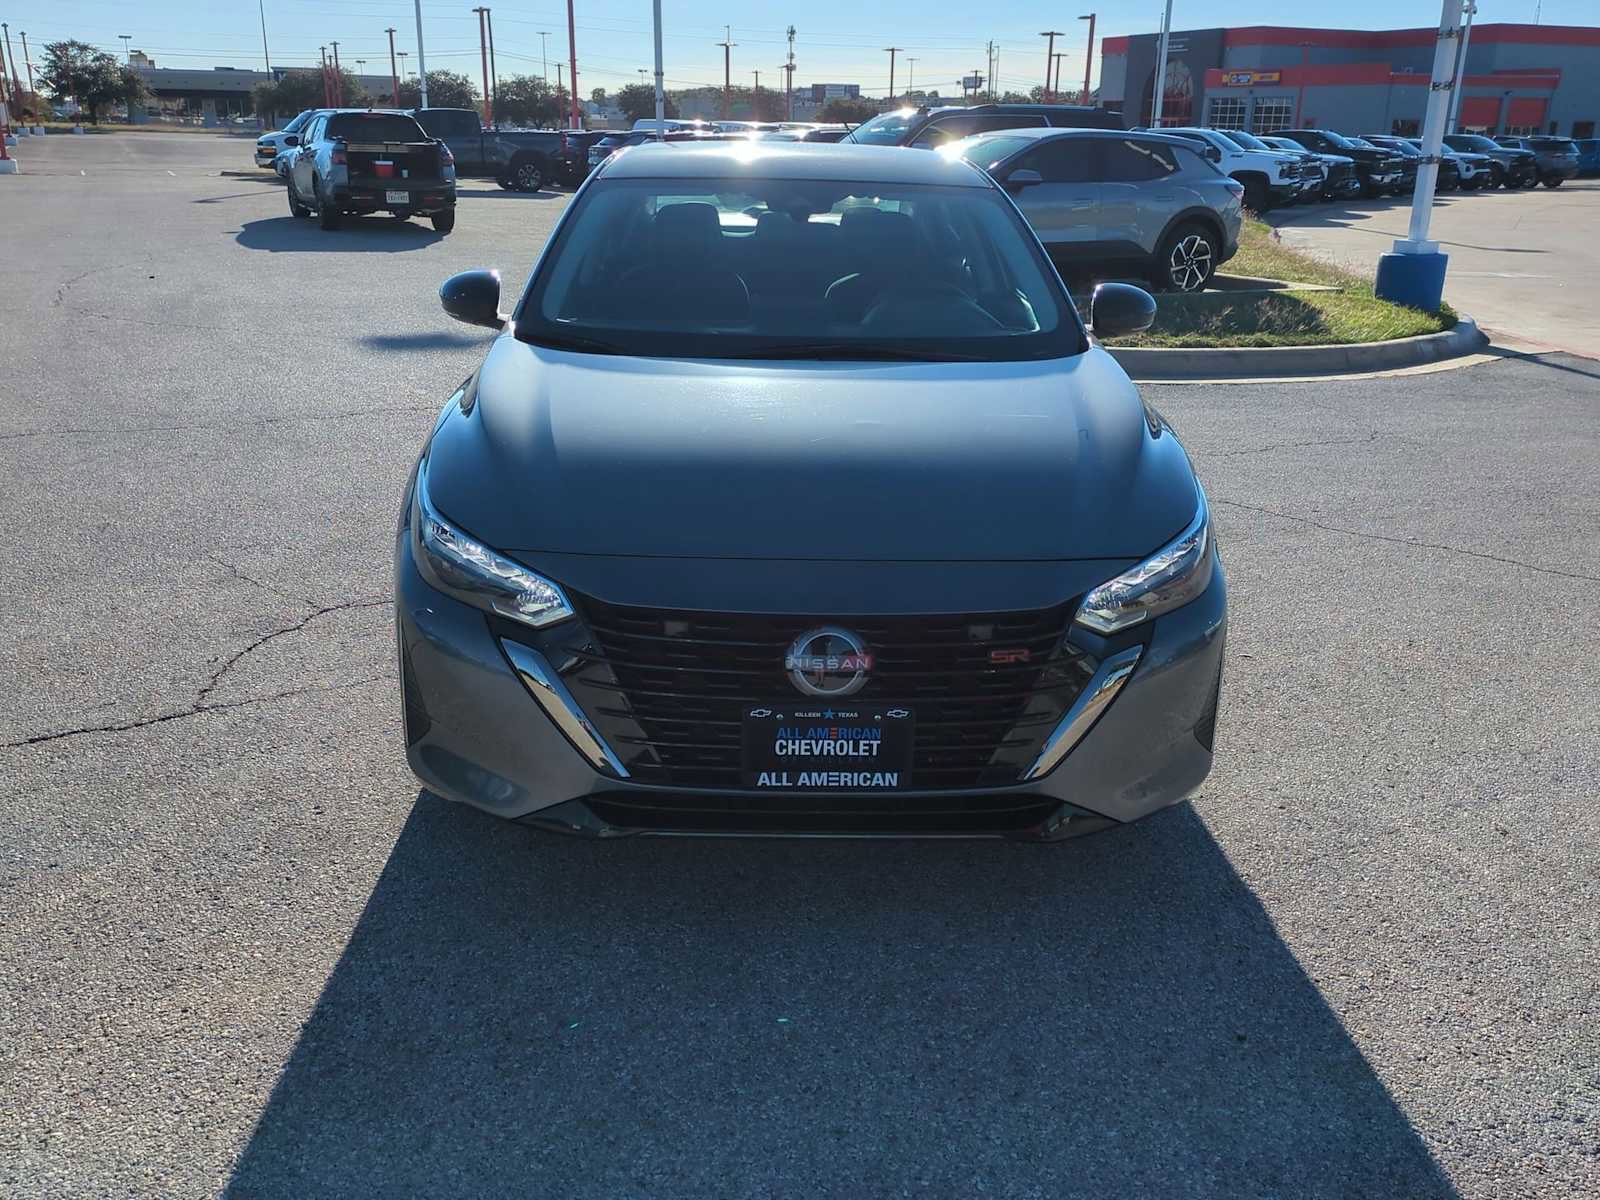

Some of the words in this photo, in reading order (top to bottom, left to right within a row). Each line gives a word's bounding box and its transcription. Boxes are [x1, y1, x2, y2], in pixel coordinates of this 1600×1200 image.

[990, 649, 1031, 663] SR
[790, 656, 868, 671] NISSAN
[776, 728, 803, 739] ALL
[807, 728, 881, 739] AMERICAN
[775, 740, 881, 756] CHEVROLET
[757, 772, 793, 786] ALL
[797, 772, 898, 786] AMERICAN
